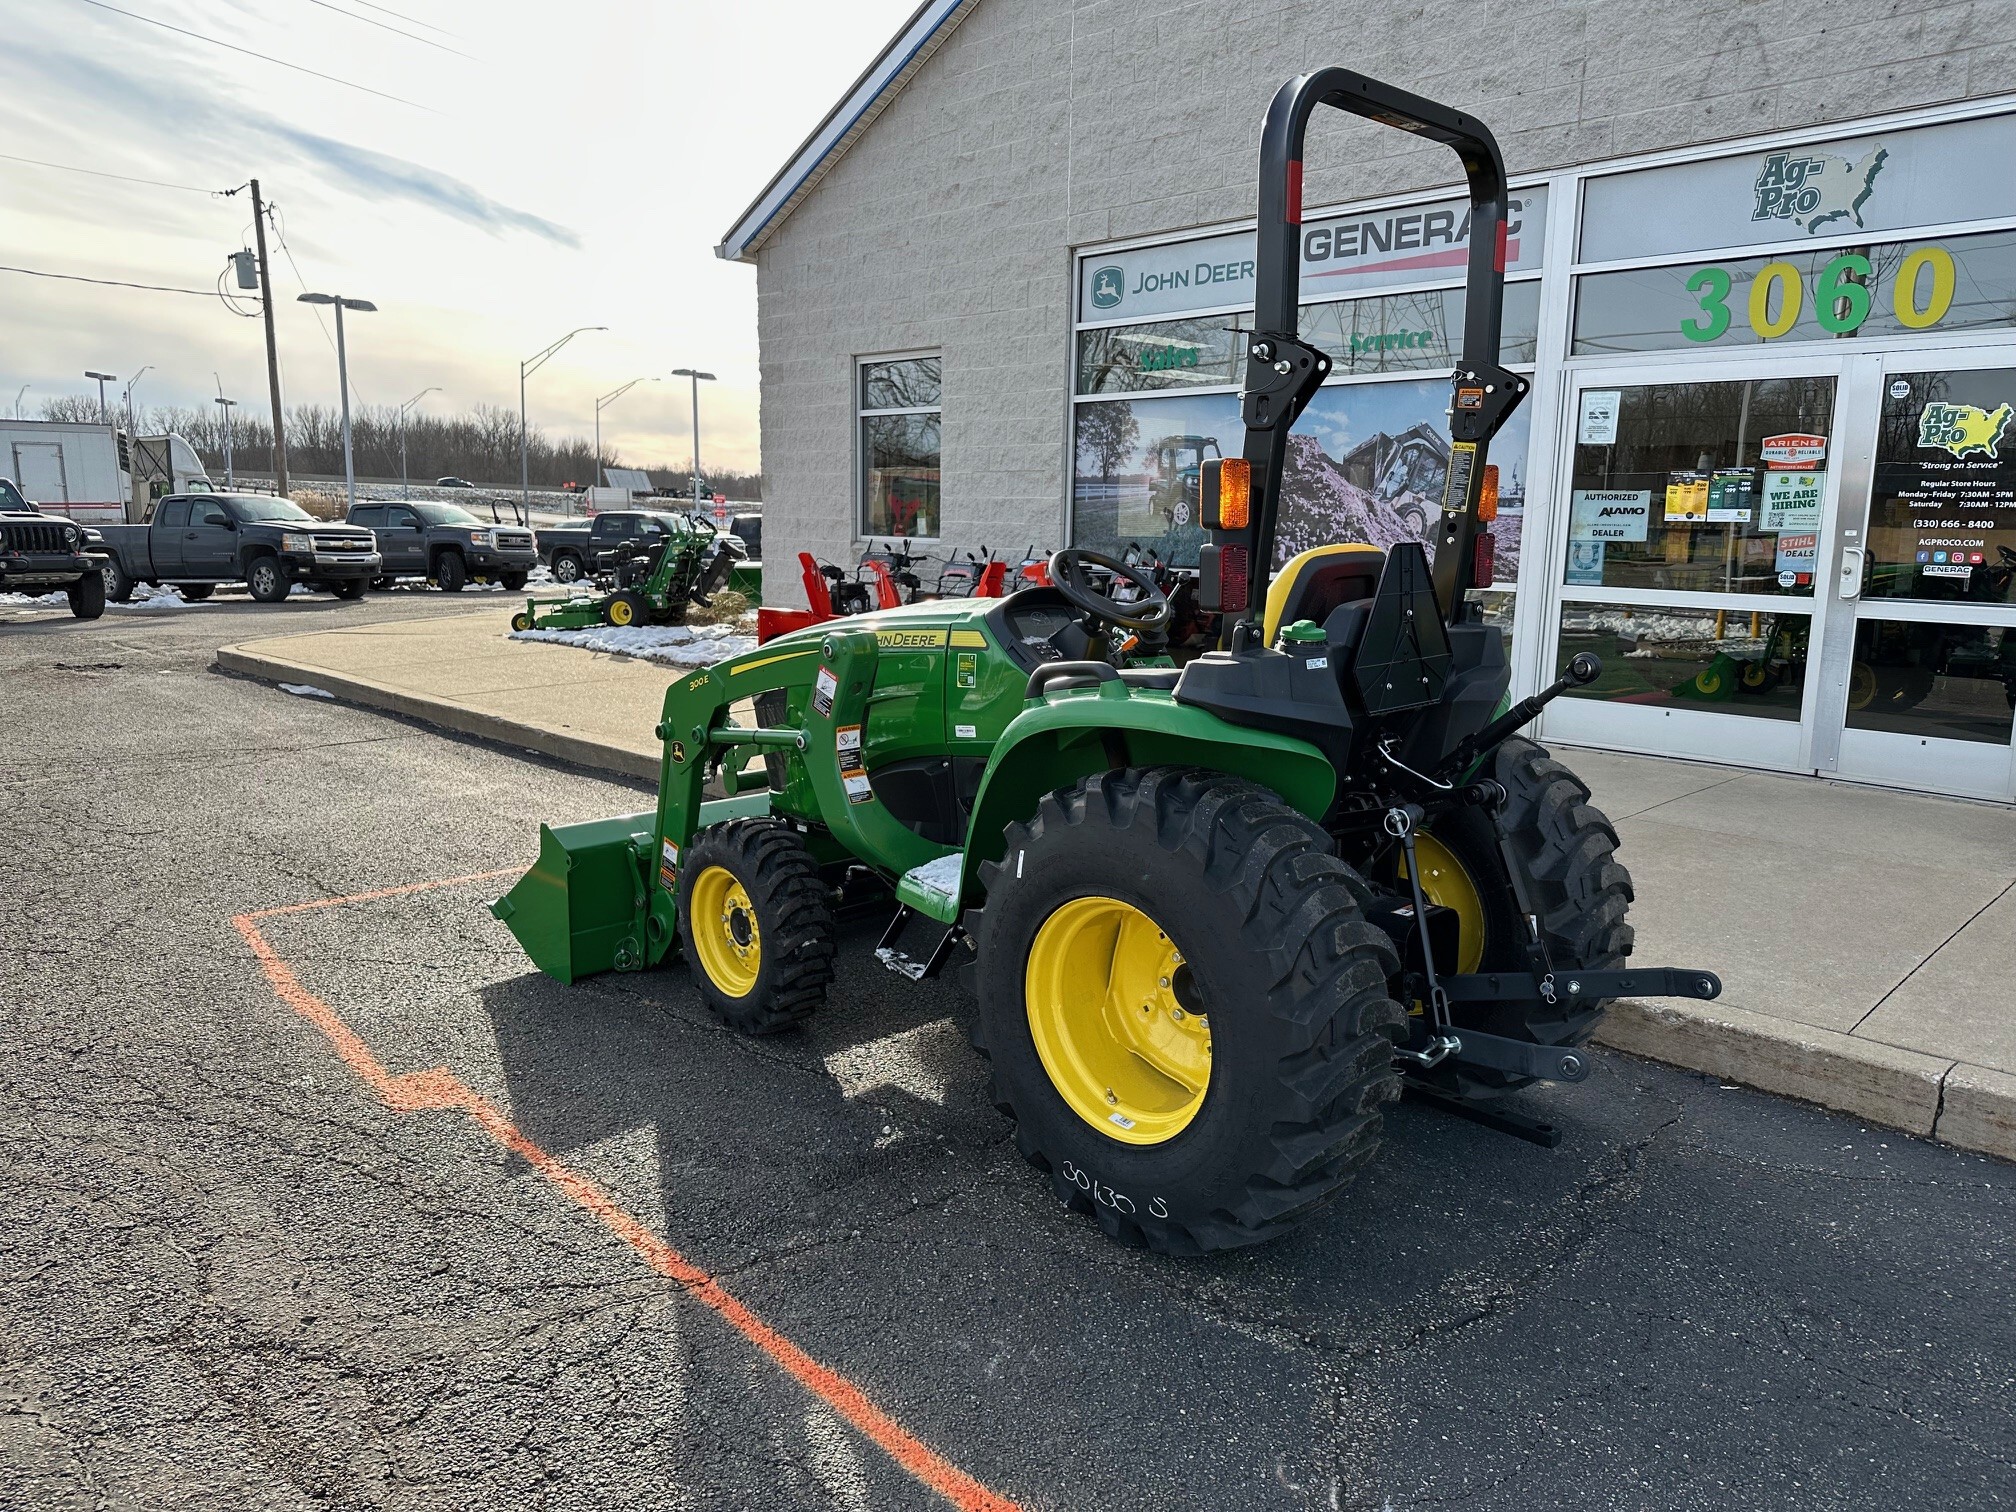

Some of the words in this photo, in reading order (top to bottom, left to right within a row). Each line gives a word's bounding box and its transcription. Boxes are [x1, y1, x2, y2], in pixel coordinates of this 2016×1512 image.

[1754, 187, 1820, 219] Pro
[1132, 269, 1190, 294] JOHN
[1194, 260, 1255, 286] DEER
[1348, 328, 1434, 353] Service
[1139, 345, 1200, 372] Sales
[1920, 424, 1967, 445] Pro
[1768, 439, 1819, 447] ARIENS
[1920, 480, 1950, 489] Regular
[1584, 493, 1639, 501] AUTHORIZED
[1770, 491, 1790, 501] WE
[1793, 489, 1818, 499] ARE
[1771, 499, 1816, 510] HIRING
[1909, 500, 1943, 508] Saturday
[1598, 507, 1646, 517] ALAMO
[1913, 519, 1939, 529] (330)
[1940, 520, 1960, 528] 666
[1967, 520, 1994, 528] 8400
[1592, 529, 1625, 537] DEALER
[1781, 536, 1814, 548] STIHL
[1918, 538, 1984, 547] AGPROCO.COM
[1785, 549, 1815, 558] DEALS
[893, 633, 936, 646] DEERE
